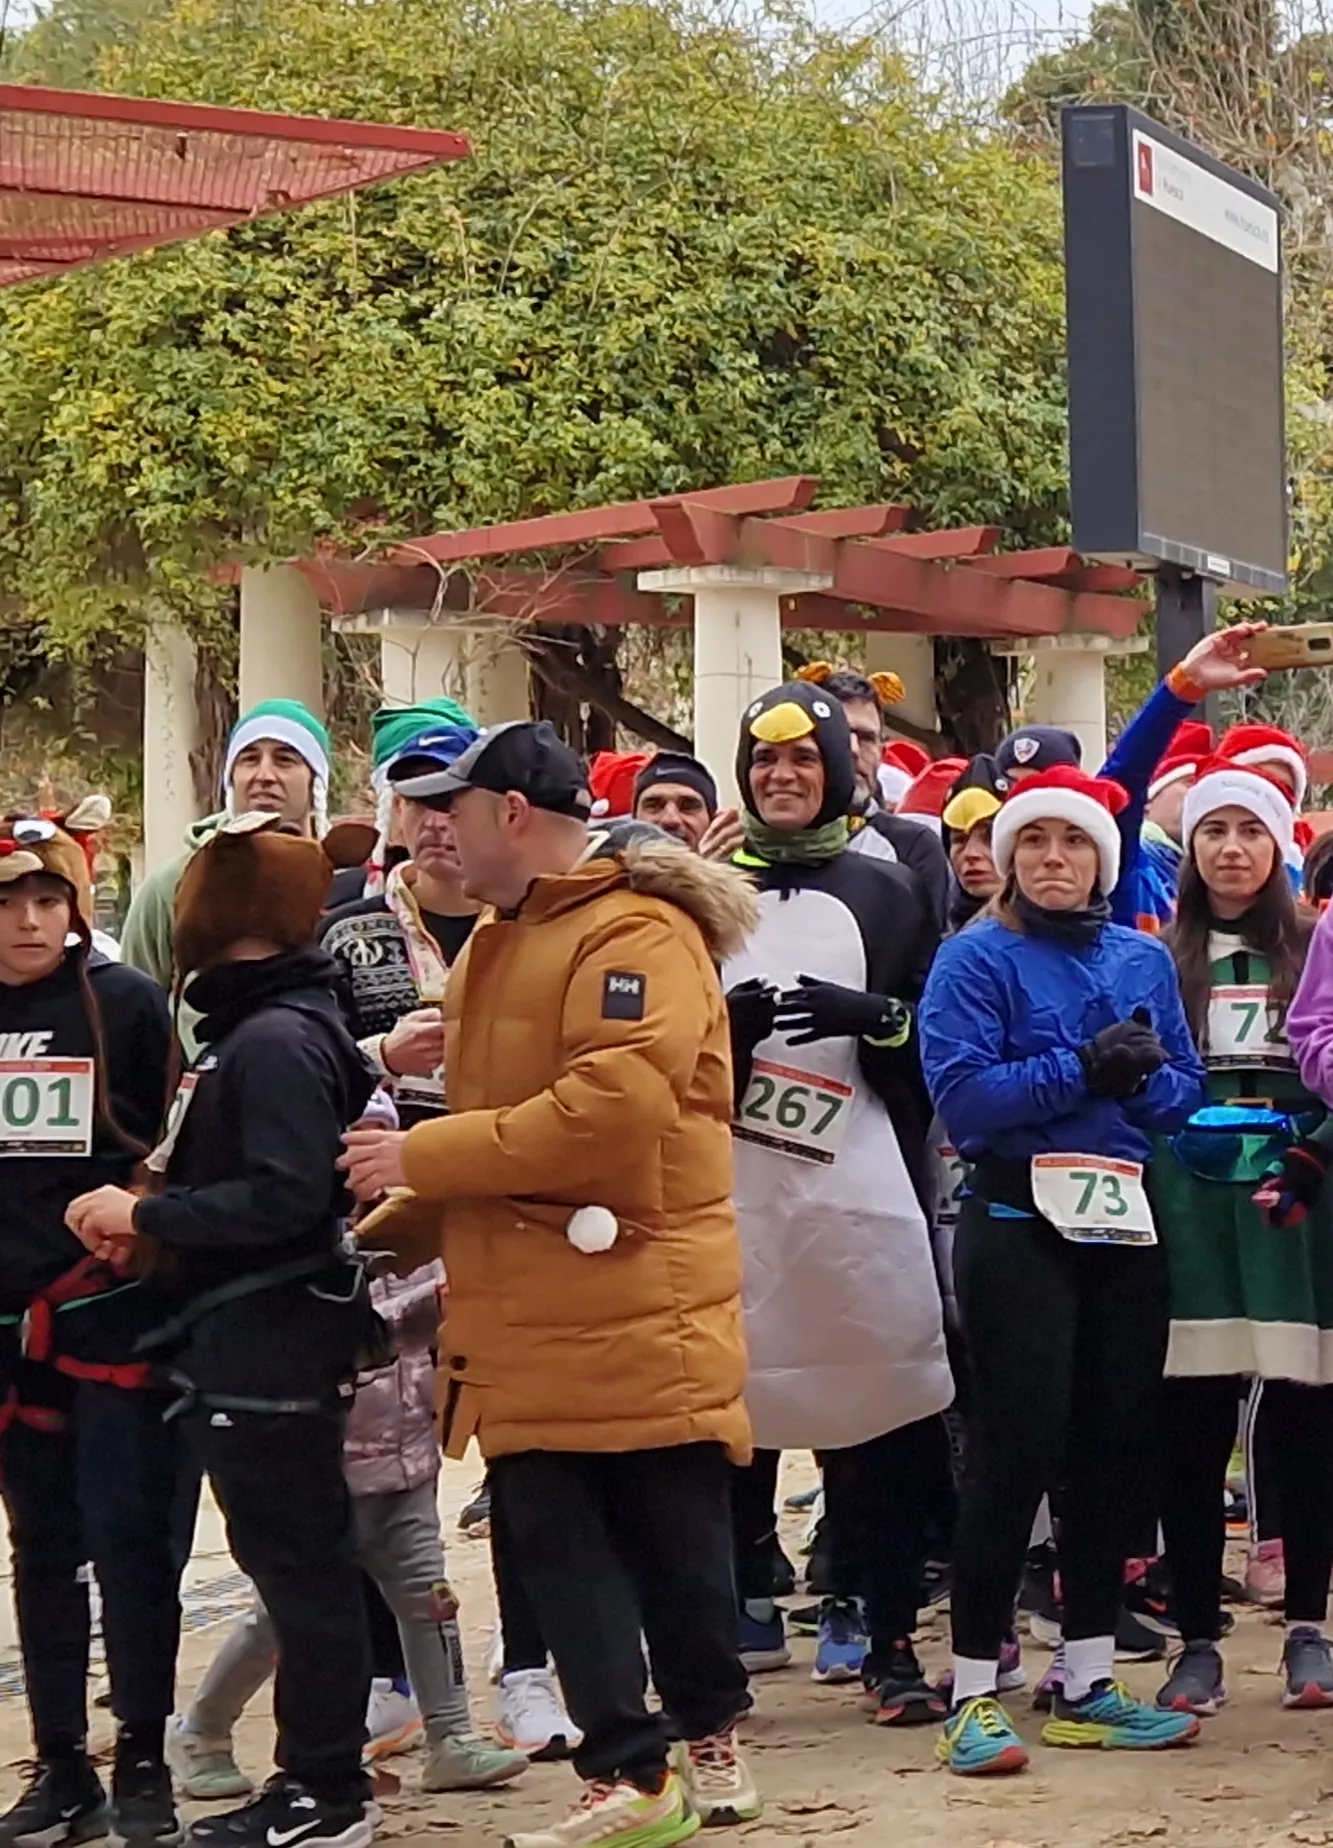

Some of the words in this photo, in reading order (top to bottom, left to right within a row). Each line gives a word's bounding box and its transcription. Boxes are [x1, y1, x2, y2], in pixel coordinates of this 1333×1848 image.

[0, 1030, 54, 1058] IKE
[745, 1075, 844, 1136] 267
[1068, 1171, 1129, 1217] 73
